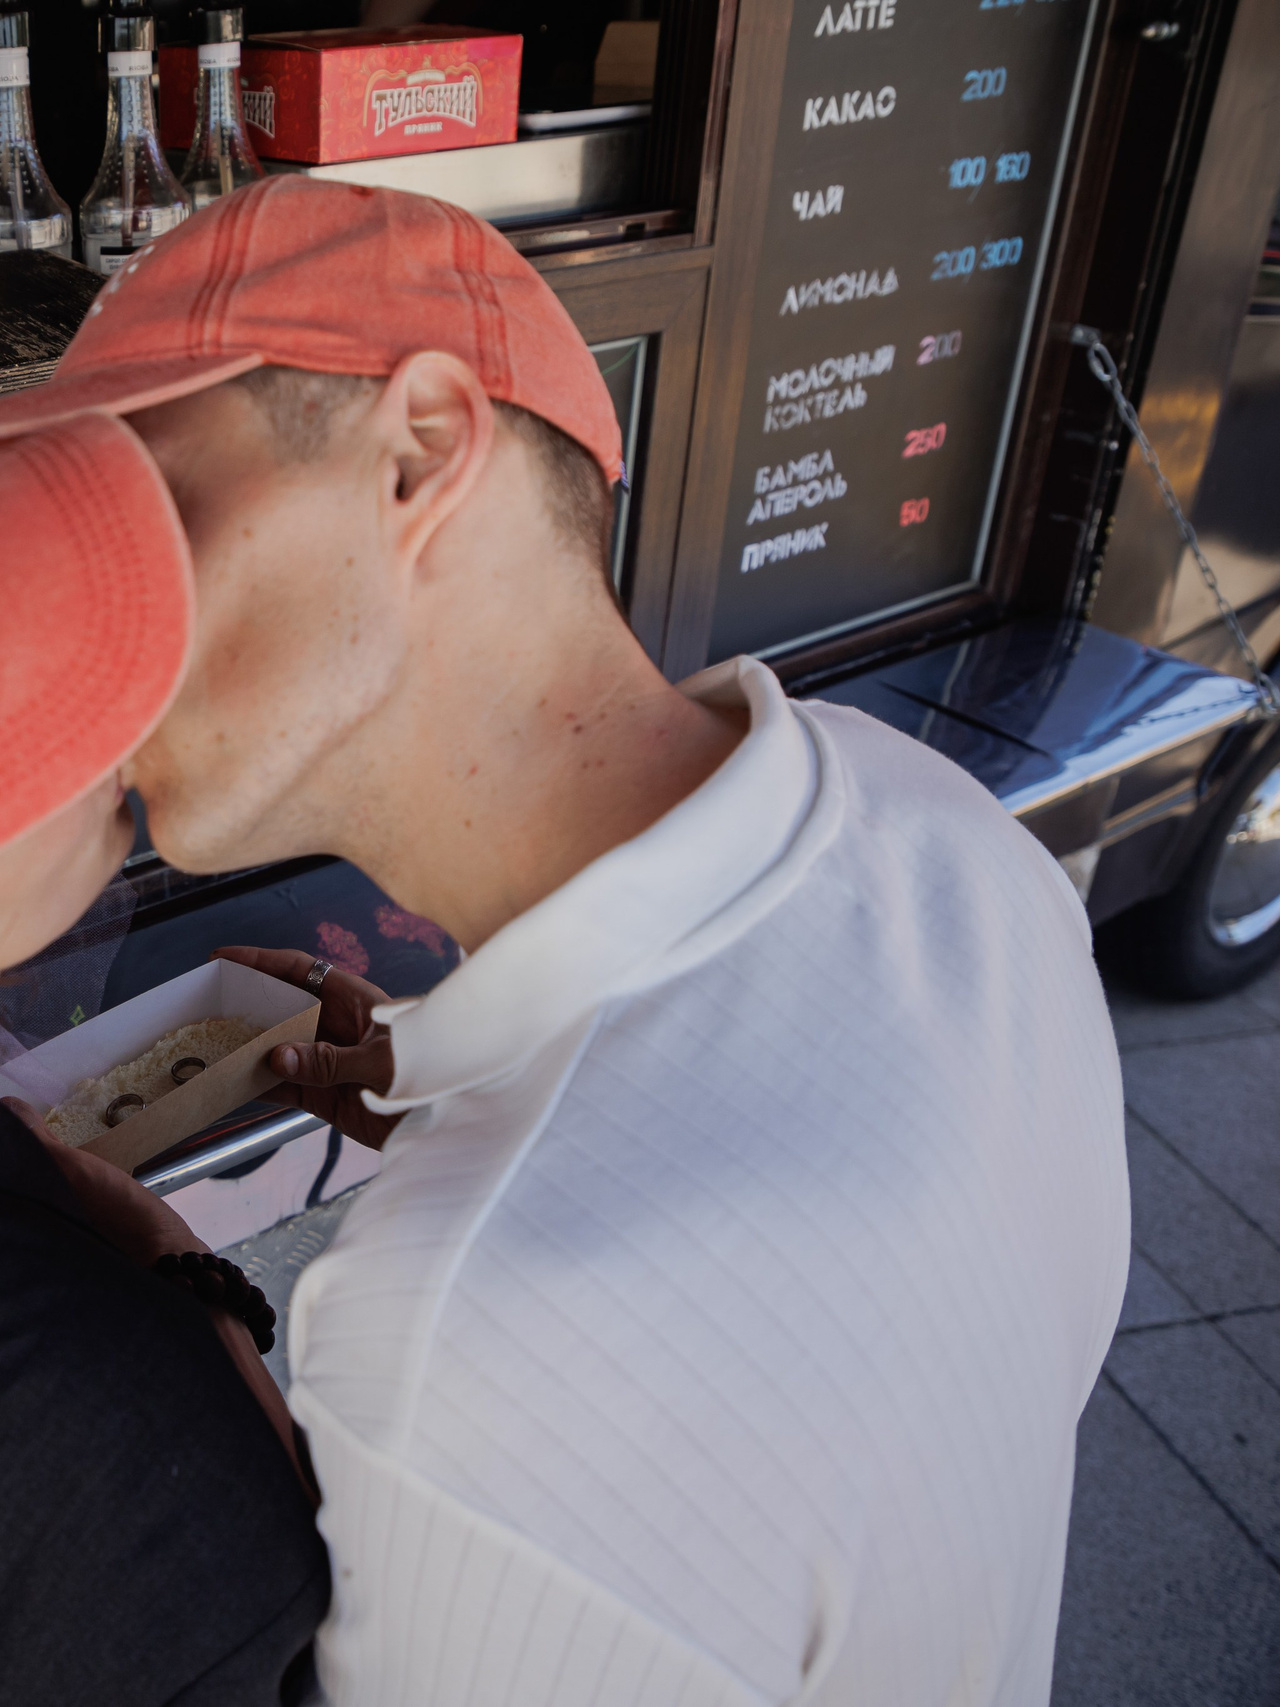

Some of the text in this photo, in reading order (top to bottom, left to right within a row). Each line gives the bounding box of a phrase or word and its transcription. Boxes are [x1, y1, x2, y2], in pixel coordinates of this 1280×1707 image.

[814, 0, 897, 38] ЛАТТЕ
[372, 75, 477, 137] ТУЛЬСКИЙ
[802, 67, 1008, 131] КАКАО 200
[792, 184, 845, 221] ЧАЙ
[779, 266, 900, 316] ЛИМОНАД
[766, 329, 963, 404] МОЛОЧНЫЙ 200
[763, 381, 869, 434] КОКТЕЛЬ
[746, 472, 848, 526] АПЕРОЛЬ
[740, 520, 830, 574] ПРЯНИК
